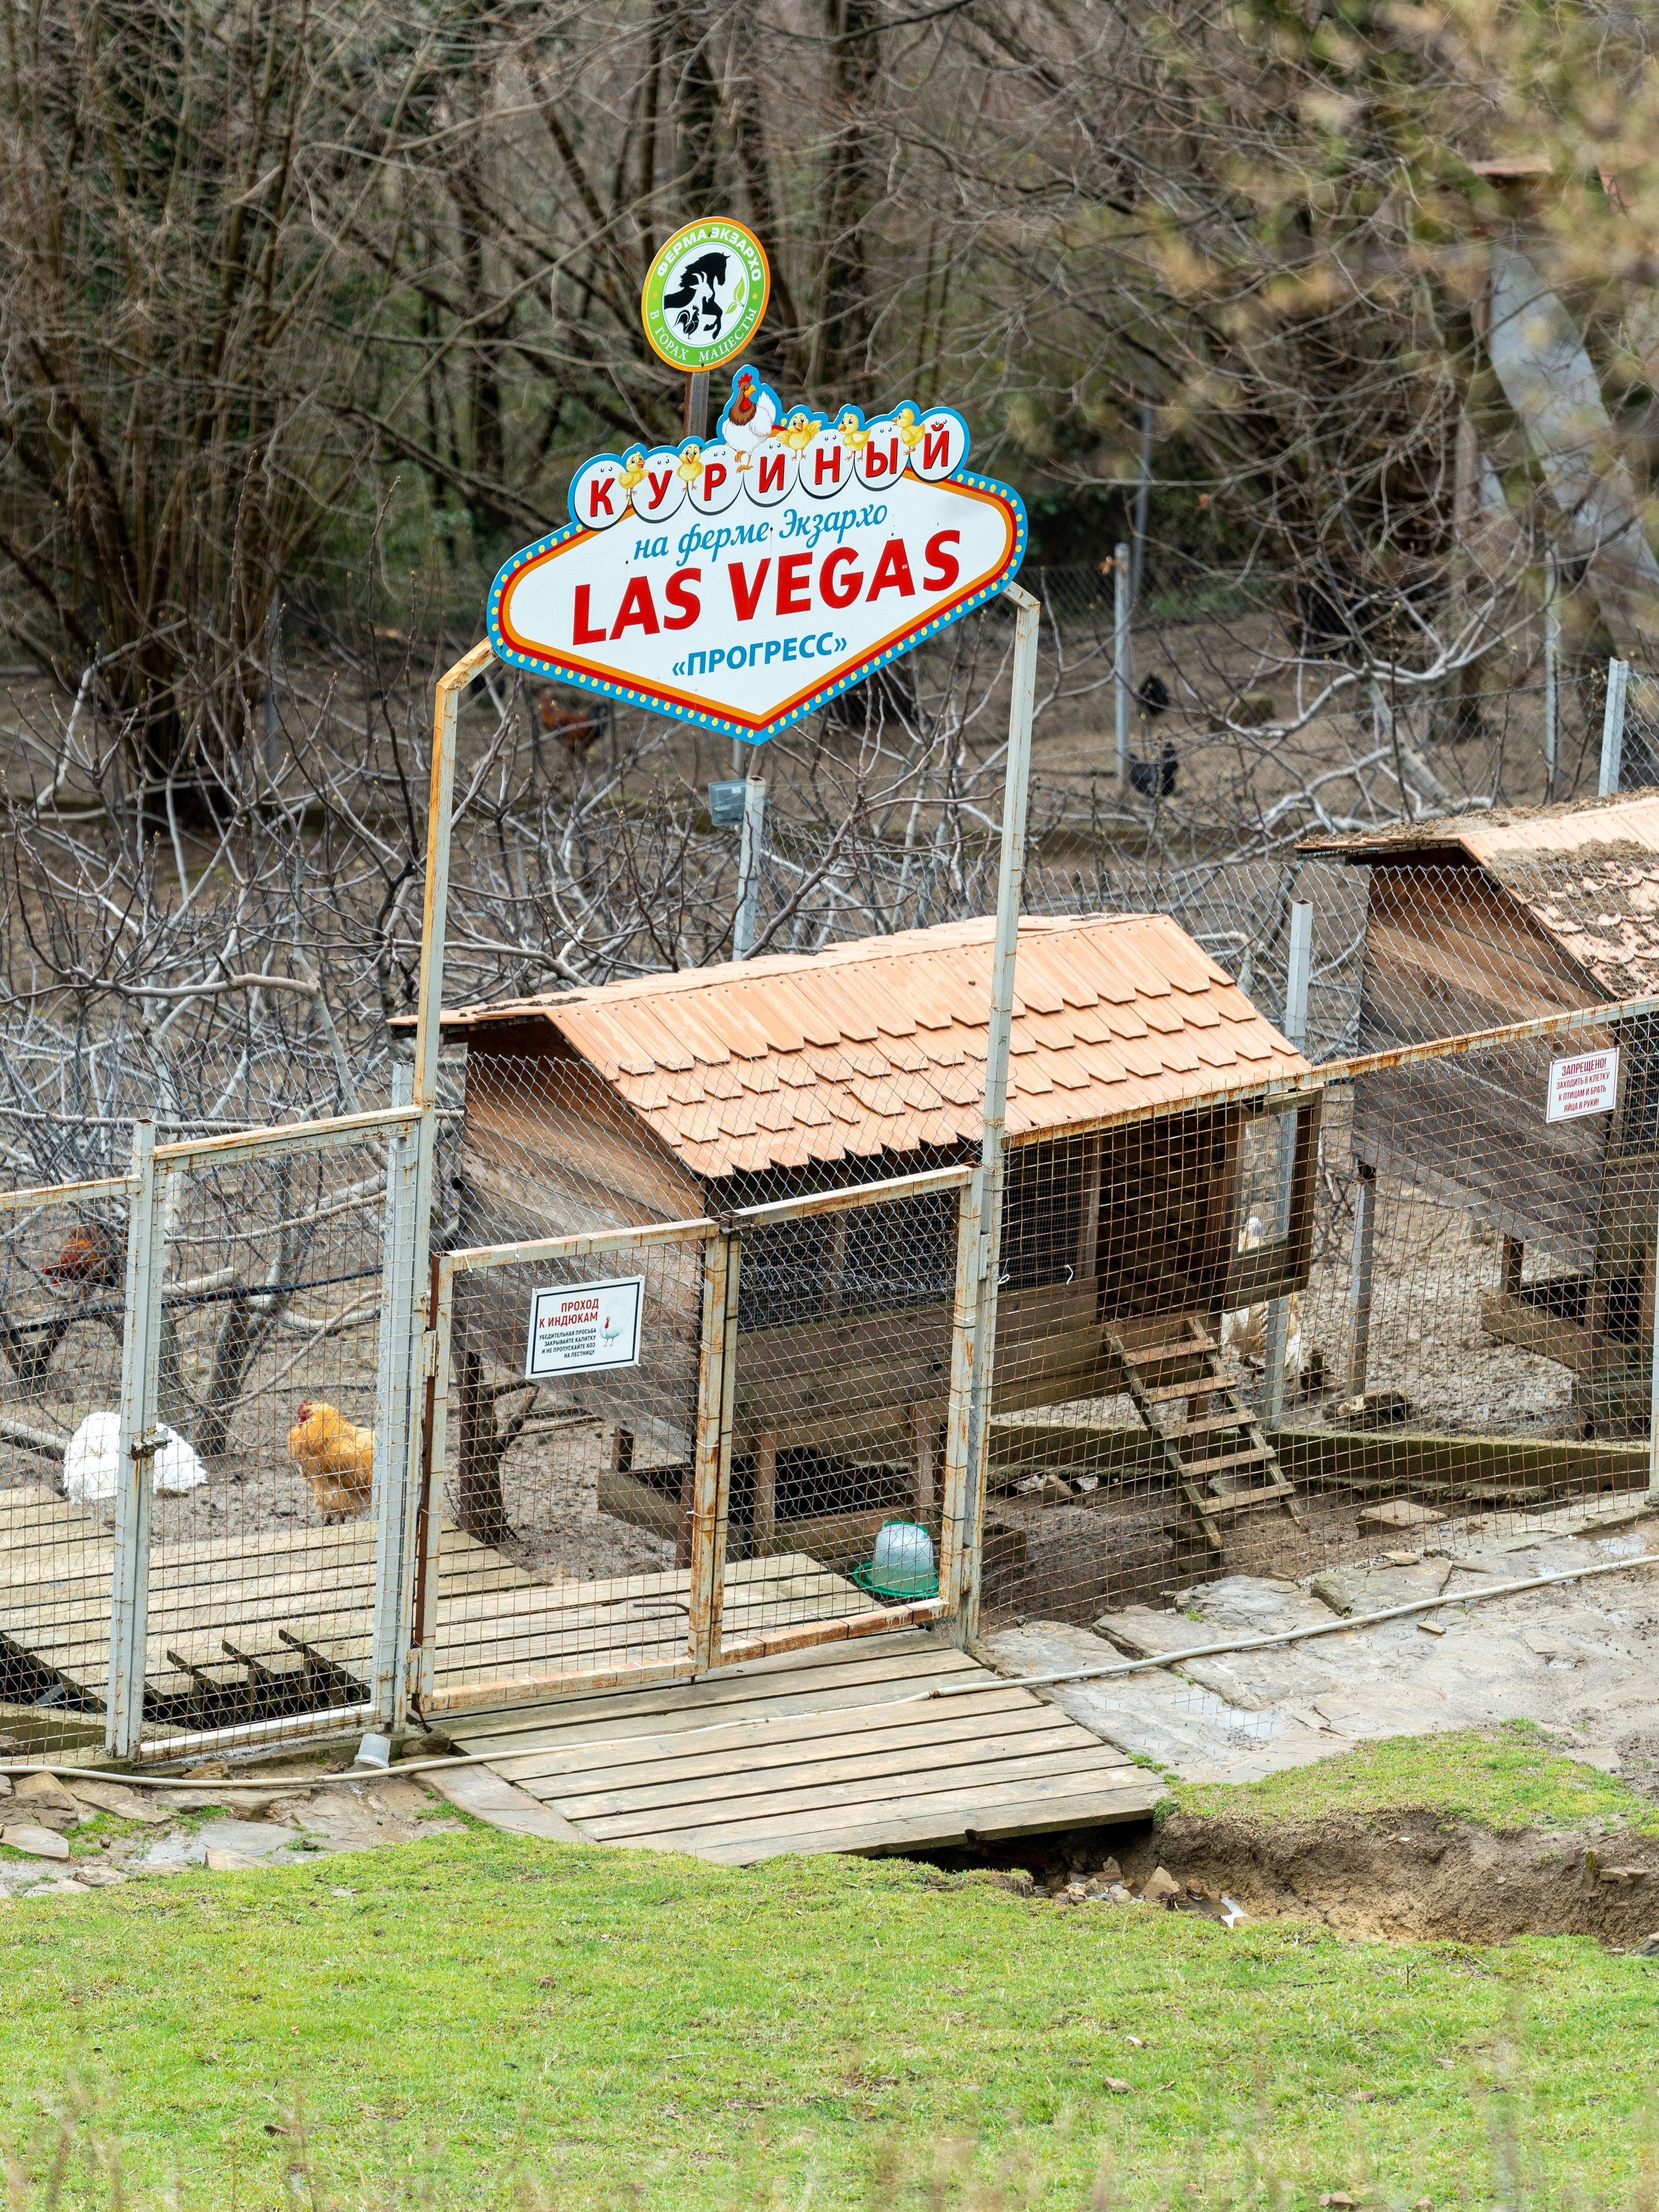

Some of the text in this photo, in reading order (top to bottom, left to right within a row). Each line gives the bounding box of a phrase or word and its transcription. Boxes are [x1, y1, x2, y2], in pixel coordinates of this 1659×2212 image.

[657, 227, 761, 281] ФЕРМА ЭКЗАРХО
[650, 309, 758, 362] В ГОРАХ МАЦЕСТЫ
[589, 418, 952, 518] КУРИНЫЙ
[634, 504, 887, 566] на ферме Экзархо
[572, 530, 960, 646] LAS VEGAS
[671, 631, 848, 677] «ПРОГРЕСС»
[1562, 1057, 1607, 1077] ЗАПРЕЩЕНО!
[1557, 1077, 1583, 1089] ЗАХОДИТЬ
[1589, 1071, 1610, 1082] КЛЕТКУ
[1563, 1089, 1584, 1100] ПТИЦАМ
[1586, 1088, 1590, 1096] И
[1590, 1084, 1606, 1095] БРАТЬ
[1564, 1102, 1577, 1112] ЯЙЦА
[1583, 1098, 1599, 1108] РУКИ!
[561, 1298, 599, 1312] ПРОХОД
[539, 1312, 598, 1328] К ИНДЮКАМ
[539, 1331, 574, 1340] УБЕДИТЕЛЬНАЯ
[544, 1337, 574, 1346] ЗАКРЫВАЙТЕ
[553, 1343, 585, 1353] ПРОПУСКАЙТЕ
